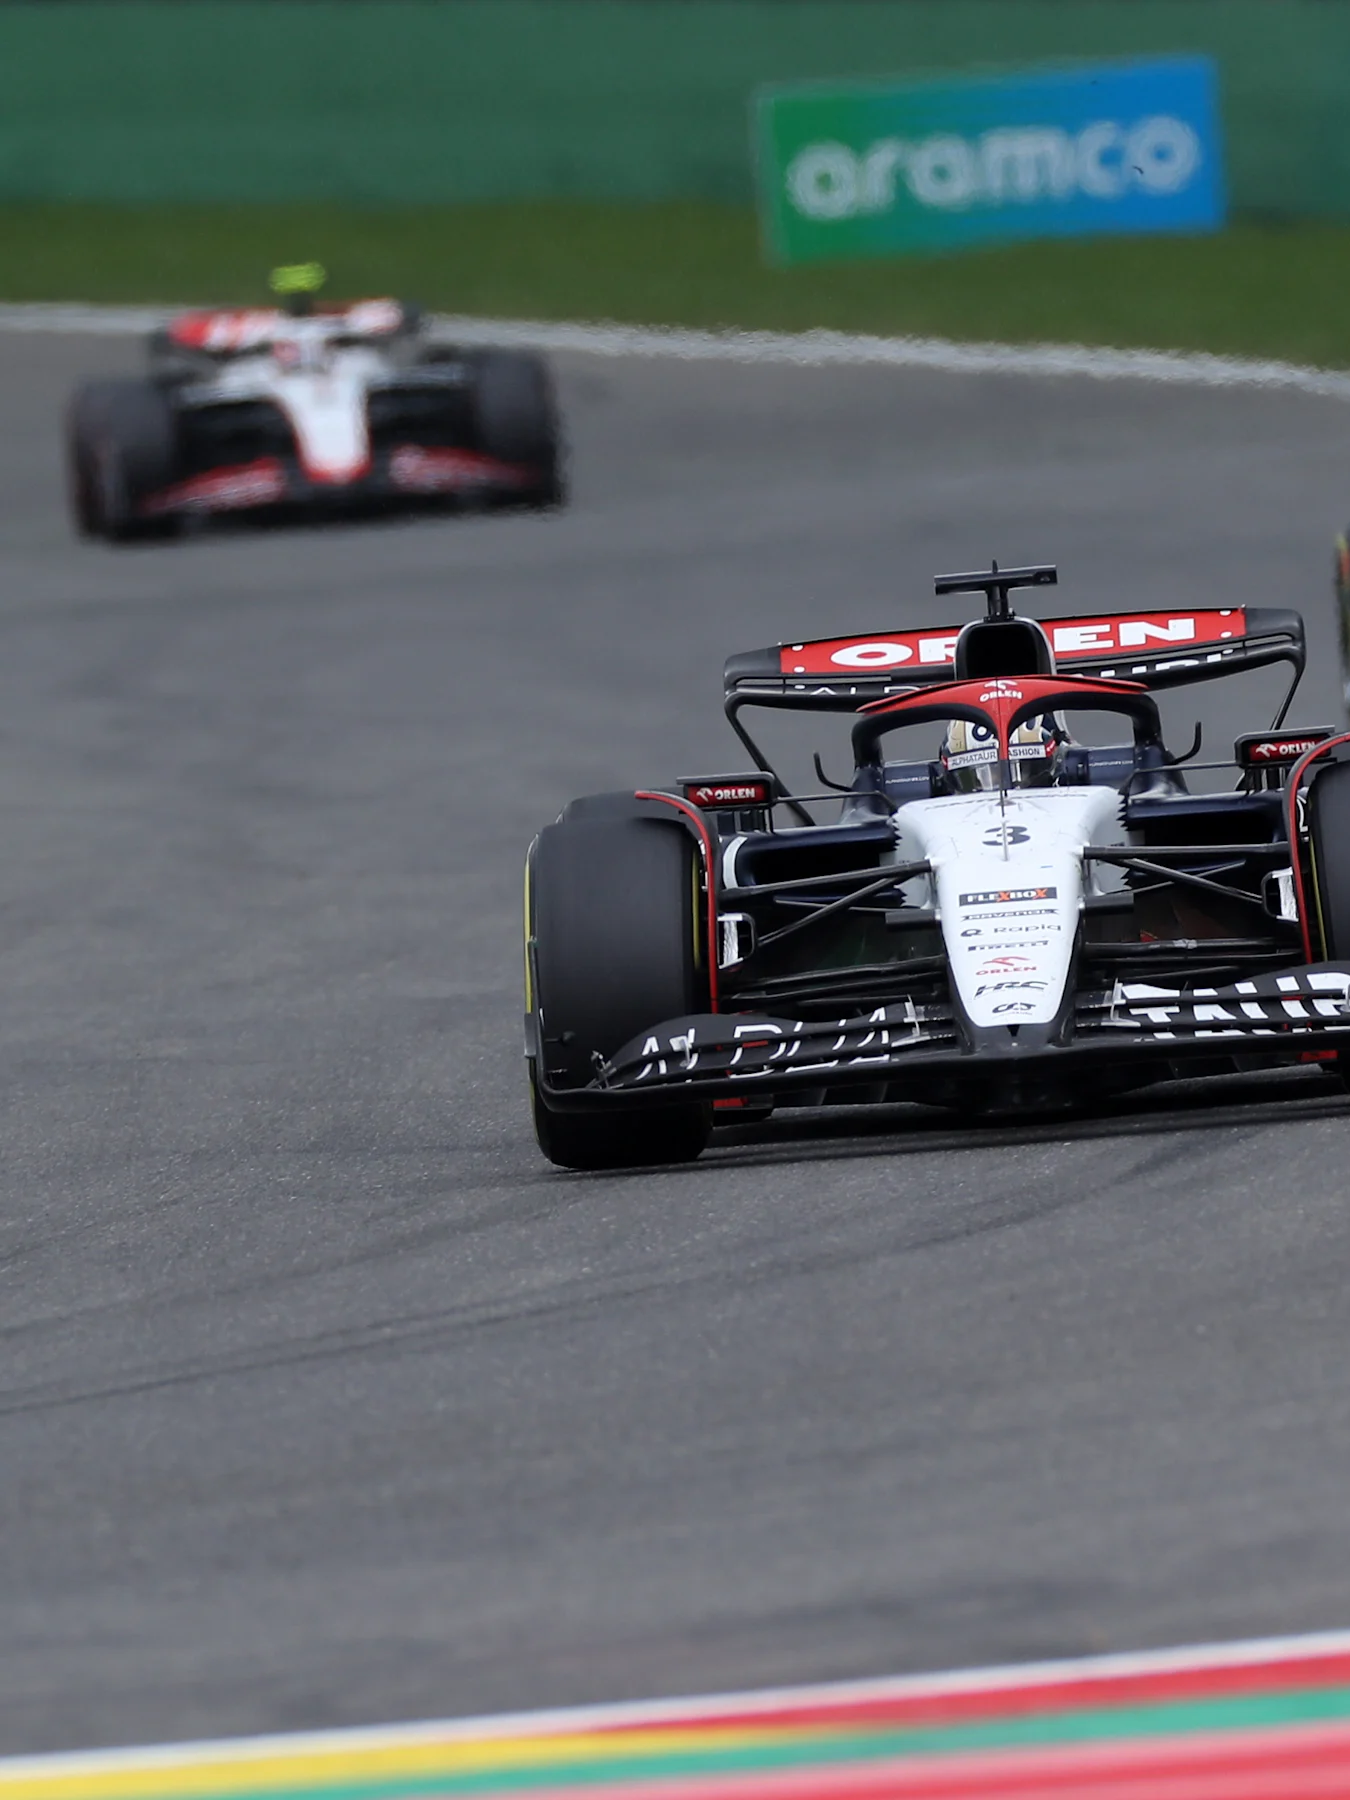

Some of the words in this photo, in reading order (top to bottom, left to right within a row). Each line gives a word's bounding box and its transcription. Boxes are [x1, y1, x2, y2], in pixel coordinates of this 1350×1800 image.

[785, 114, 1200, 220] aramco
[830, 617, 1196, 667] OREN
[979, 690, 1023, 703] ORLEN
[714, 787, 755, 799] ORLEN
[982, 826, 1031, 847] 3
[967, 886, 1049, 903] FLEXBOX
[976, 966, 1037, 976] ORLEN
